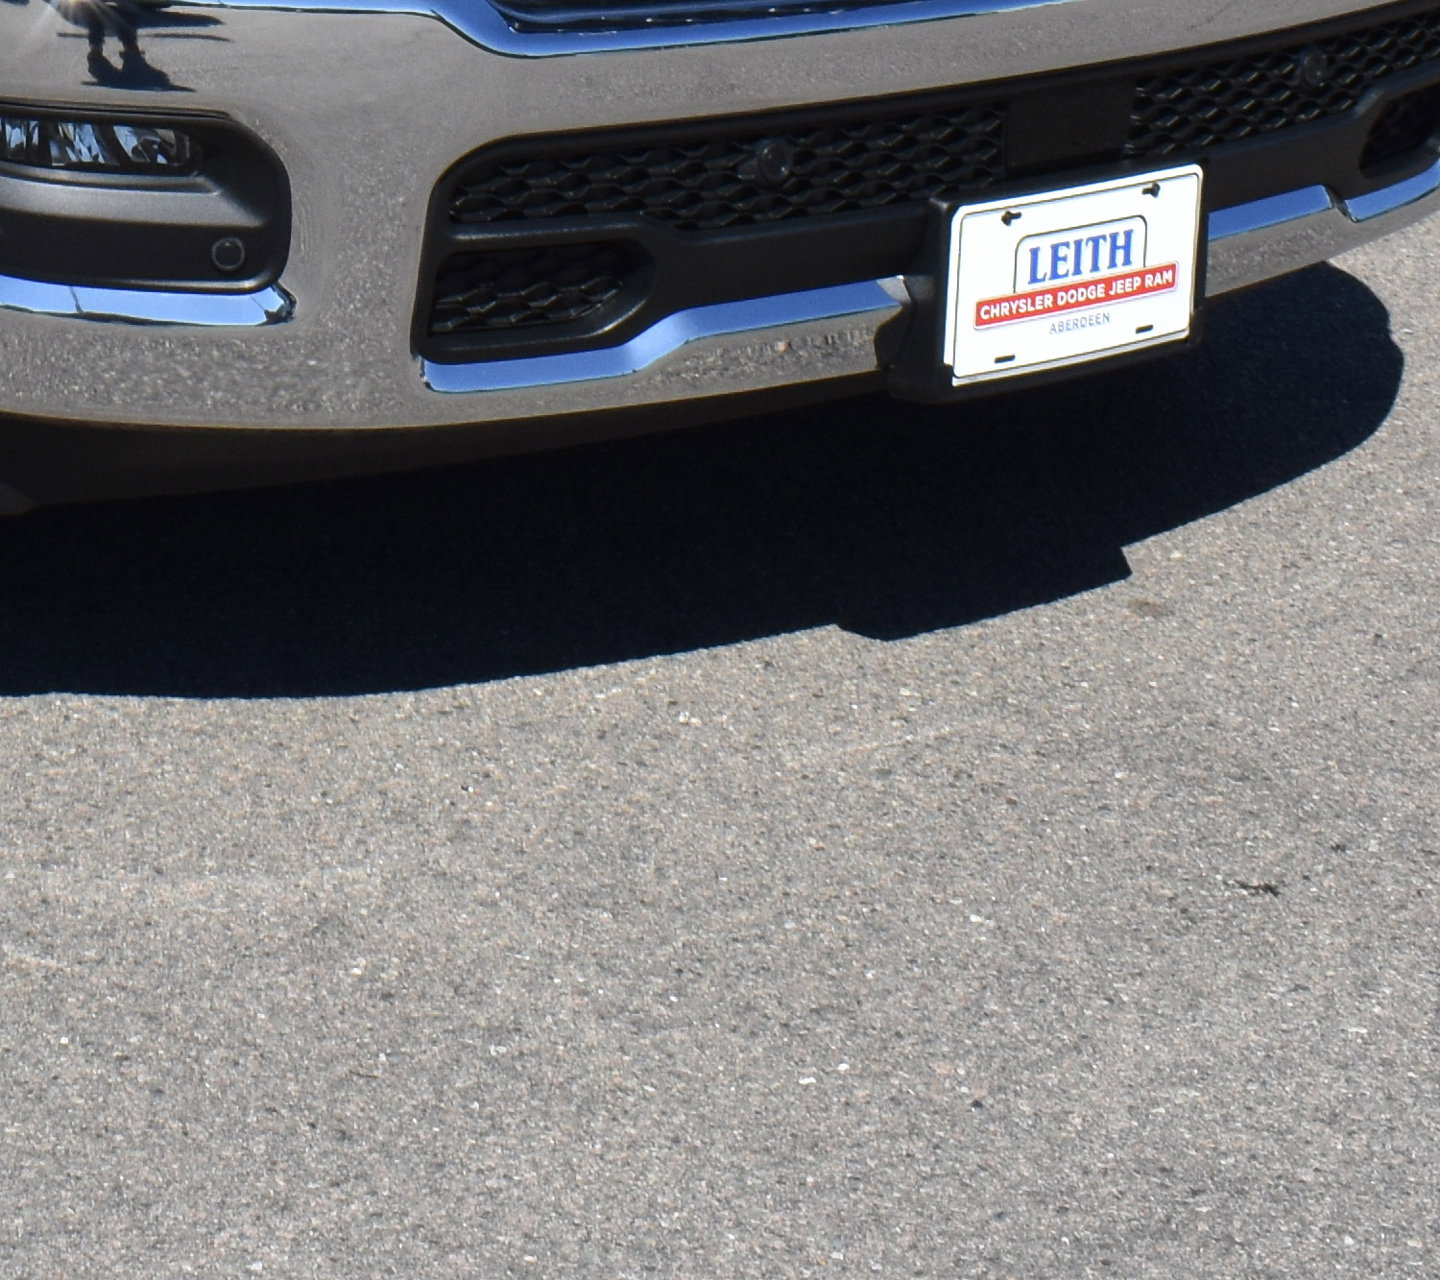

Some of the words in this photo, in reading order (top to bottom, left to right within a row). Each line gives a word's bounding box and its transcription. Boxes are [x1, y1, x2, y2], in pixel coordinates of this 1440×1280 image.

[1027, 229, 1134, 285] LEITH
[979, 292, 1053, 320] CHRYSLER
[1057, 283, 1105, 307] DODGE
[1109, 275, 1142, 298] JEEP
[1145, 268, 1173, 289] RAM
[1048, 312, 1111, 335] ABERDEEN
